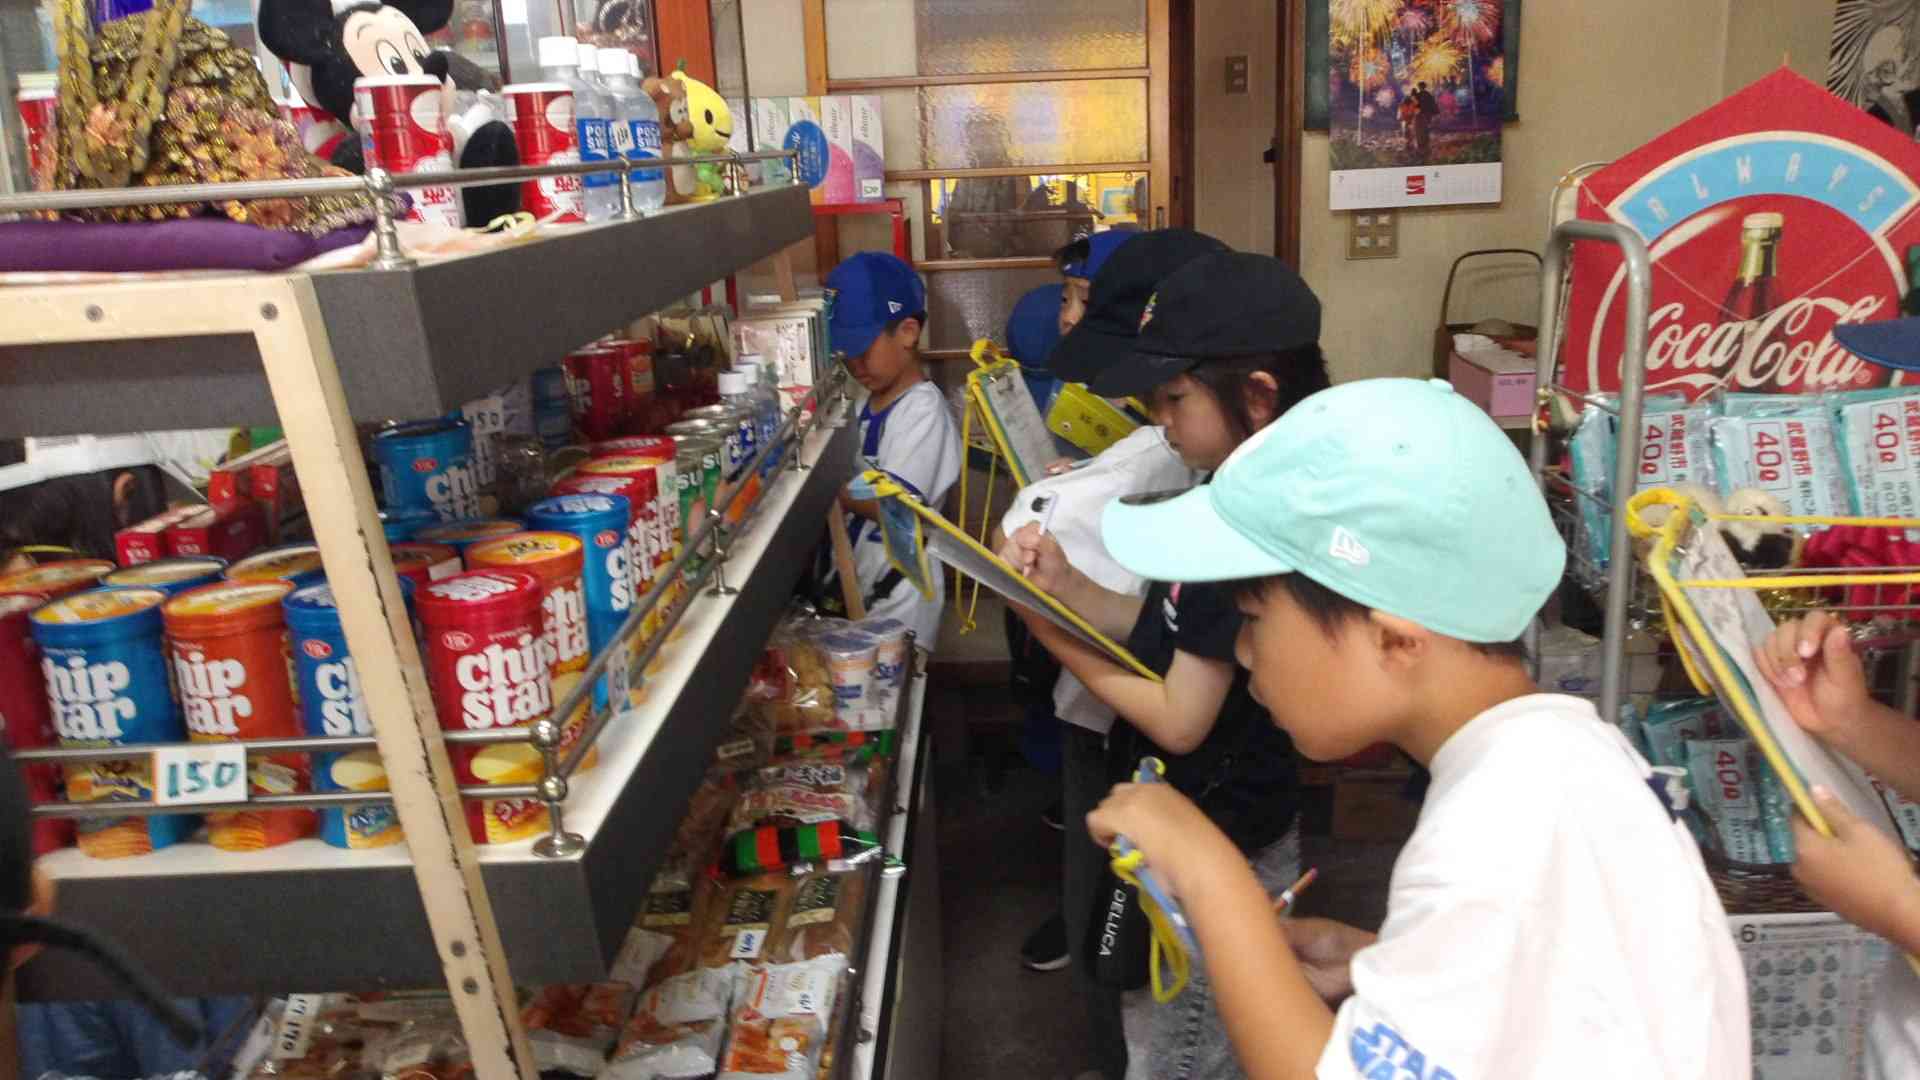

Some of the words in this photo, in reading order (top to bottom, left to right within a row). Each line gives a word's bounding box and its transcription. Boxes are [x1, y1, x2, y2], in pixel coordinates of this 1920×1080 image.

[1647, 152, 1886, 223] ALWAYS
[165, 760, 240, 799] 150
[1098, 888, 1127, 956] DELUCA
